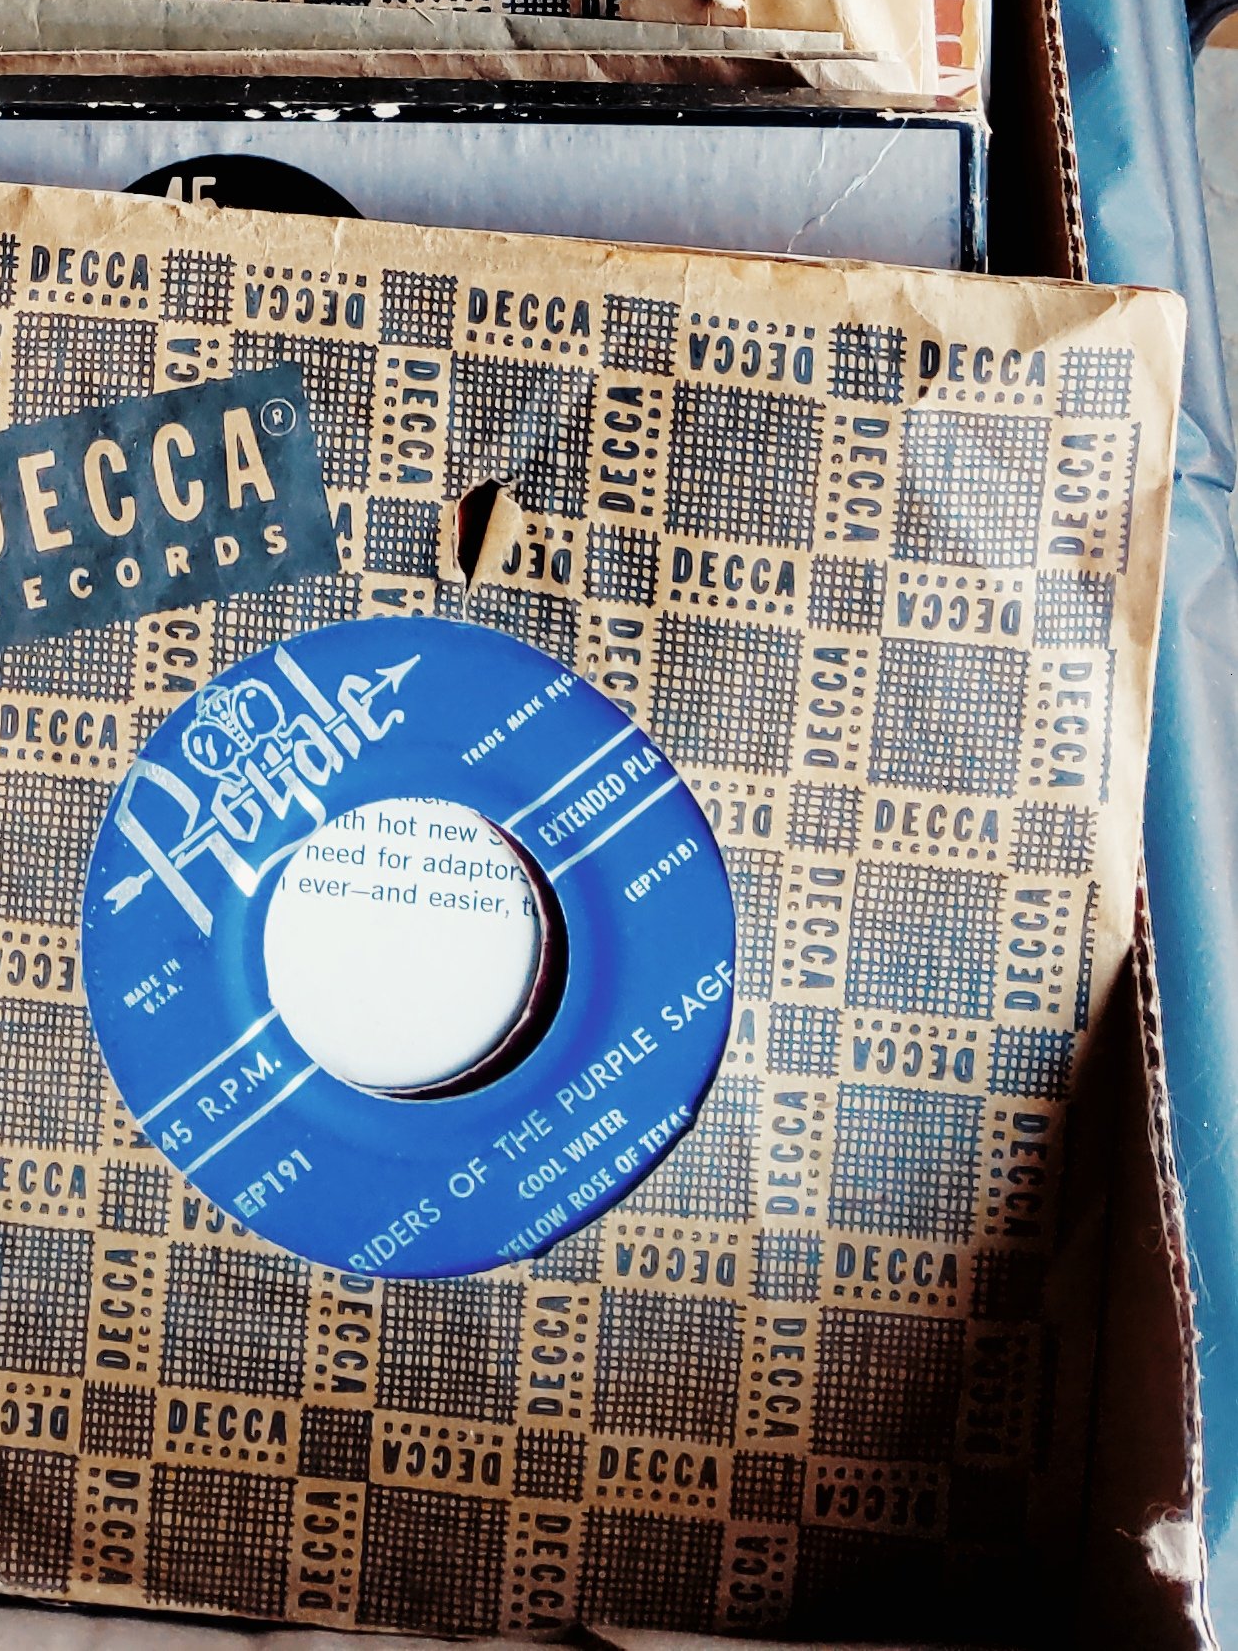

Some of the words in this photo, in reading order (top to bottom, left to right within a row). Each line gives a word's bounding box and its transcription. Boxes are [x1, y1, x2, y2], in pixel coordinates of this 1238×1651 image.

[30, 247, 150, 292] DECCA
[467, 287, 591, 331] DECCA
[919, 341, 1047, 388] DECCA
[396, 358, 440, 485] DECCA
[1048, 432, 1098, 557] DECCA
[673, 547, 796, 598] DECCA
[0, 703, 118, 751] DECCA
[462, 728, 506, 766] TRADE
[506, 695, 545, 732] MARK
[378, 811, 417, 837] hot
[429, 821, 478, 843] new
[538, 773, 626, 847] EXTENDED
[875, 800, 999, 845] DECCA
[306, 843, 366, 865] need
[378, 846, 413, 871] for
[623, 838, 699, 903] (EP191B)
[428, 889, 510, 919] easier,
[123, 974, 161, 1009] MADE
[162, 958, 181, 977] IN
[143, 983, 184, 1015] U.S.A.
[161, 1119, 193, 1153] 45
[196, 1051, 282, 1122] R.P.M.
[347, 1197, 442, 1274] RIDERS
[448, 1157, 488, 1199] OF
[492, 1108, 553, 1161] THE
[555, 1026, 660, 1115] PURPLE
[517, 1157, 569, 1200] COOL
[562, 1108, 629, 1163] WATER
[232, 1148, 313, 1218] EP191
[496, 1203, 569, 1263] YELLOW
[567, 1167, 616, 1213] ROSE
[614, 1145, 641, 1176] OF
